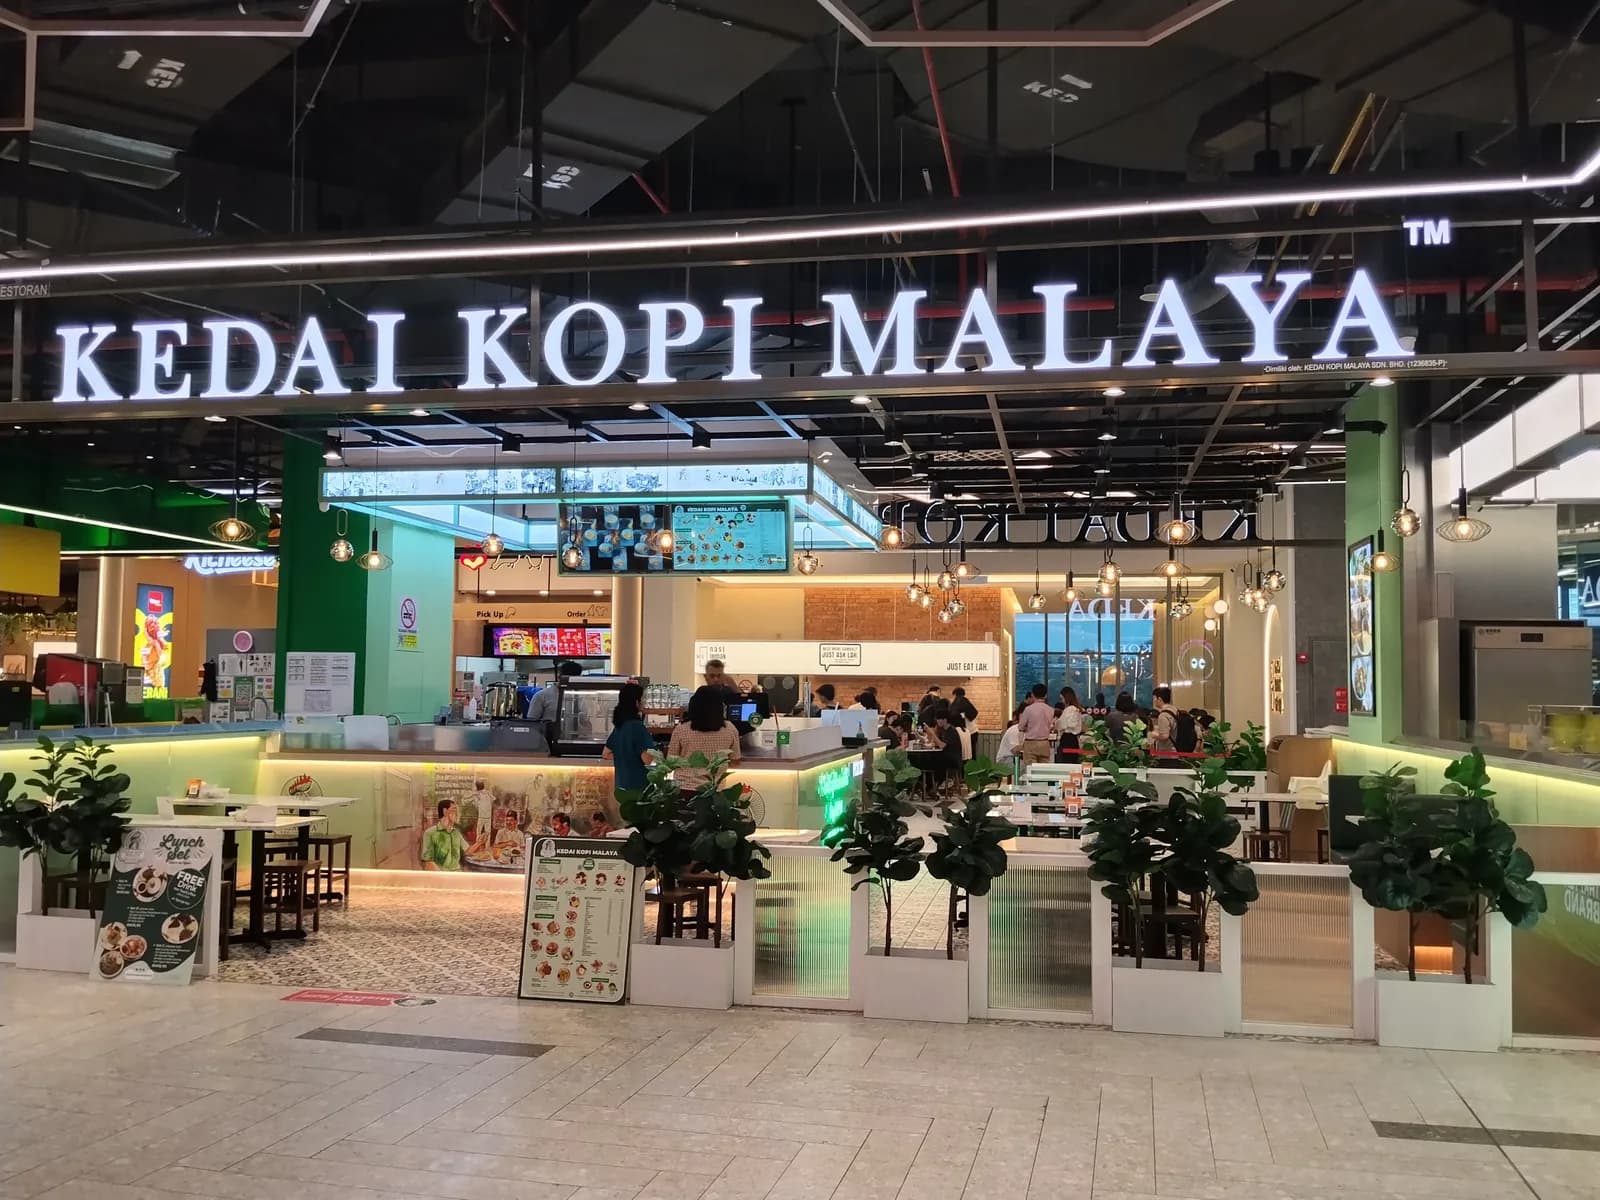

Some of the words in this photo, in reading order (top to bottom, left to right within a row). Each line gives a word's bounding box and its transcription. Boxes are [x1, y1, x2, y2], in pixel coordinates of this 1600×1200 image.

[1402, 219, 1450, 246] TM
[53, 313, 405, 402] KEDAI
[457, 298, 763, 390] KOPI
[822, 270, 1415, 377] MALAYA
[1304, 362, 1325, 372] KEDAI
[1326, 362, 1343, 371] KOPI
[1344, 361, 1371, 370] MALAYA
[476, 610, 491, 618] Pick
[493, 610, 504, 619] Up
[566, 610, 586, 618] Order
[946, 662, 962, 671] JUST
[963, 662, 974, 671] EAT
[160, 833, 206, 851] Lunch
[165, 847, 191, 863] Set
[177, 871, 205, 888] FREE
[177, 880, 198, 893] Drink
